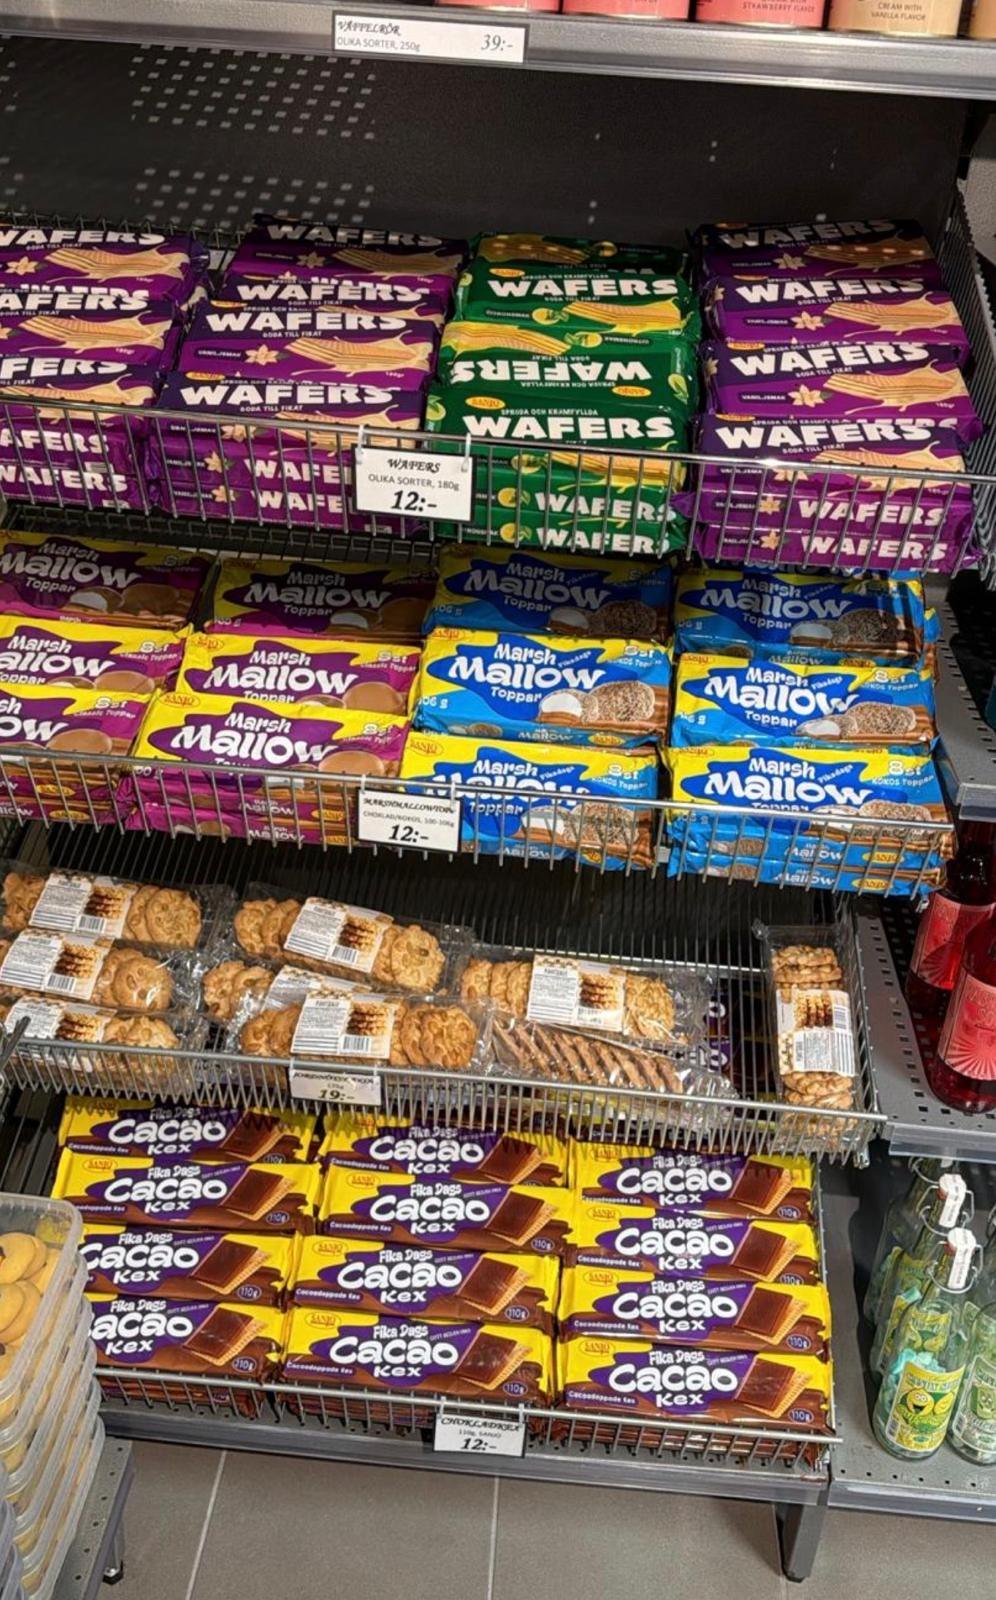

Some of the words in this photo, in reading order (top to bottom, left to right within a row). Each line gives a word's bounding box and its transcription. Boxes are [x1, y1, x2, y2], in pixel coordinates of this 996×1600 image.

[267, 225, 442, 246] WAFERS
[720, 220, 897, 249] WAFERS
[237, 284, 422, 302] WAFERS
[488, 279, 678, 296] WAFERS
[736, 278, 924, 304] WAFERS
[205, 312, 407, 331] WAFERS
[730, 344, 929, 376] WAFERS
[451, 360, 652, 383] WAFERS
[180, 384, 392, 406] WAFERS
[463, 416, 674, 439] WAFERS
[715, 423, 932, 450] WAFERS
[388, 458, 440, 473] WAFERS
[368, 474, 395, 483] OLIKA
[398, 476, 435, 488] SORTER,
[438, 480, 459, 491] 180g
[391, 490, 437, 512] 12:-
[799, 500, 946, 527] WAFERS
[39, 542, 100, 562] Marsh
[506, 562, 565, 582] Marsh
[243, 583, 392, 608] Mallow
[464, 570, 611, 610] Mallow
[742, 578, 802, 598] Marsh
[700, 587, 853, 619] Mallow
[743, 612, 791, 629] Toppar
[7, 635, 72, 654] Marsh
[249, 649, 311, 666] Marsh
[494, 643, 557, 666] Marsh
[203, 663, 359, 694] Mallow
[448, 656, 606, 690] Mallow
[746, 666, 809, 687] Marsh
[491, 686, 543, 703] Toppar
[704, 676, 859, 715] Mallow
[224, 712, 292, 734] Marsh
[745, 711, 798, 728] Toppar
[170, 724, 339, 764] Mallow
[473, 760, 538, 777] Marsh
[749, 757, 816, 779] Marsh
[704, 772, 873, 805] Mallow
[389, 824, 429, 842] 12:-
[108, 1119, 227, 1144] Cacao
[408, 1127, 433, 1139] Fika
[434, 1126, 458, 1138] Dags
[147, 1144, 191, 1155] Kex
[368, 1136, 484, 1163] Cacao
[407, 1162, 450, 1175] Kex
[653, 1156, 675, 1169] Fika
[677, 1155, 702, 1167] Dags
[147, 1166, 172, 1179] Fika
[173, 1165, 201, 1178] Dags
[616, 1167, 733, 1194] Cacao
[103, 1177, 227, 1203] Cacao
[410, 1184, 433, 1197] Fika
[435, 1183, 462, 1195] Dags
[144, 1201, 191, 1214] Kex
[369, 1195, 490, 1222] Cacao
[659, 1194, 702, 1206] Kex
[410, 1221, 456, 1234] Kex
[652, 1217, 676, 1230] Fika
[677, 1216, 703, 1229] Dags
[118, 1233, 142, 1245] Fika
[144, 1232, 174, 1244] Dags
[615, 1227, 735, 1257] Cacao
[79, 1242, 199, 1270] Cacao
[379, 1250, 404, 1263] Fika
[405, 1249, 433, 1261] Dags
[658, 1256, 703, 1270] Kex
[113, 1270, 161, 1284] Kex
[337, 1261, 463, 1289] Cacao
[240, 1286, 258, 1298] 110g
[651, 1281, 675, 1294] Fika
[676, 1279, 705, 1293] Dags
[110, 1300, 135, 1313] Fika
[137, 1299, 166, 1311] Dags
[380, 1291, 427, 1303] Kex
[612, 1292, 739, 1319] Cacao
[507, 1308, 526, 1319] 110g
[87, 1313, 194, 1341] acao
[373, 1325, 398, 1339] Fika
[400, 1324, 429, 1338] Dags
[655, 1319, 702, 1332] Kex
[105, 1340, 153, 1355] Kex
[329, 1336, 459, 1365] Cacao
[649, 1351, 674, 1365] Fika
[676, 1350, 705, 1364] Dags
[373, 1365, 421, 1378] Kex
[608, 1363, 738, 1392] Cacao
[506, 1383, 525, 1394] 110g
[655, 1392, 704, 1406] Kex
[791, 1411, 811, 1422] 110g
[461, 1438, 497, 1451] 12:-
